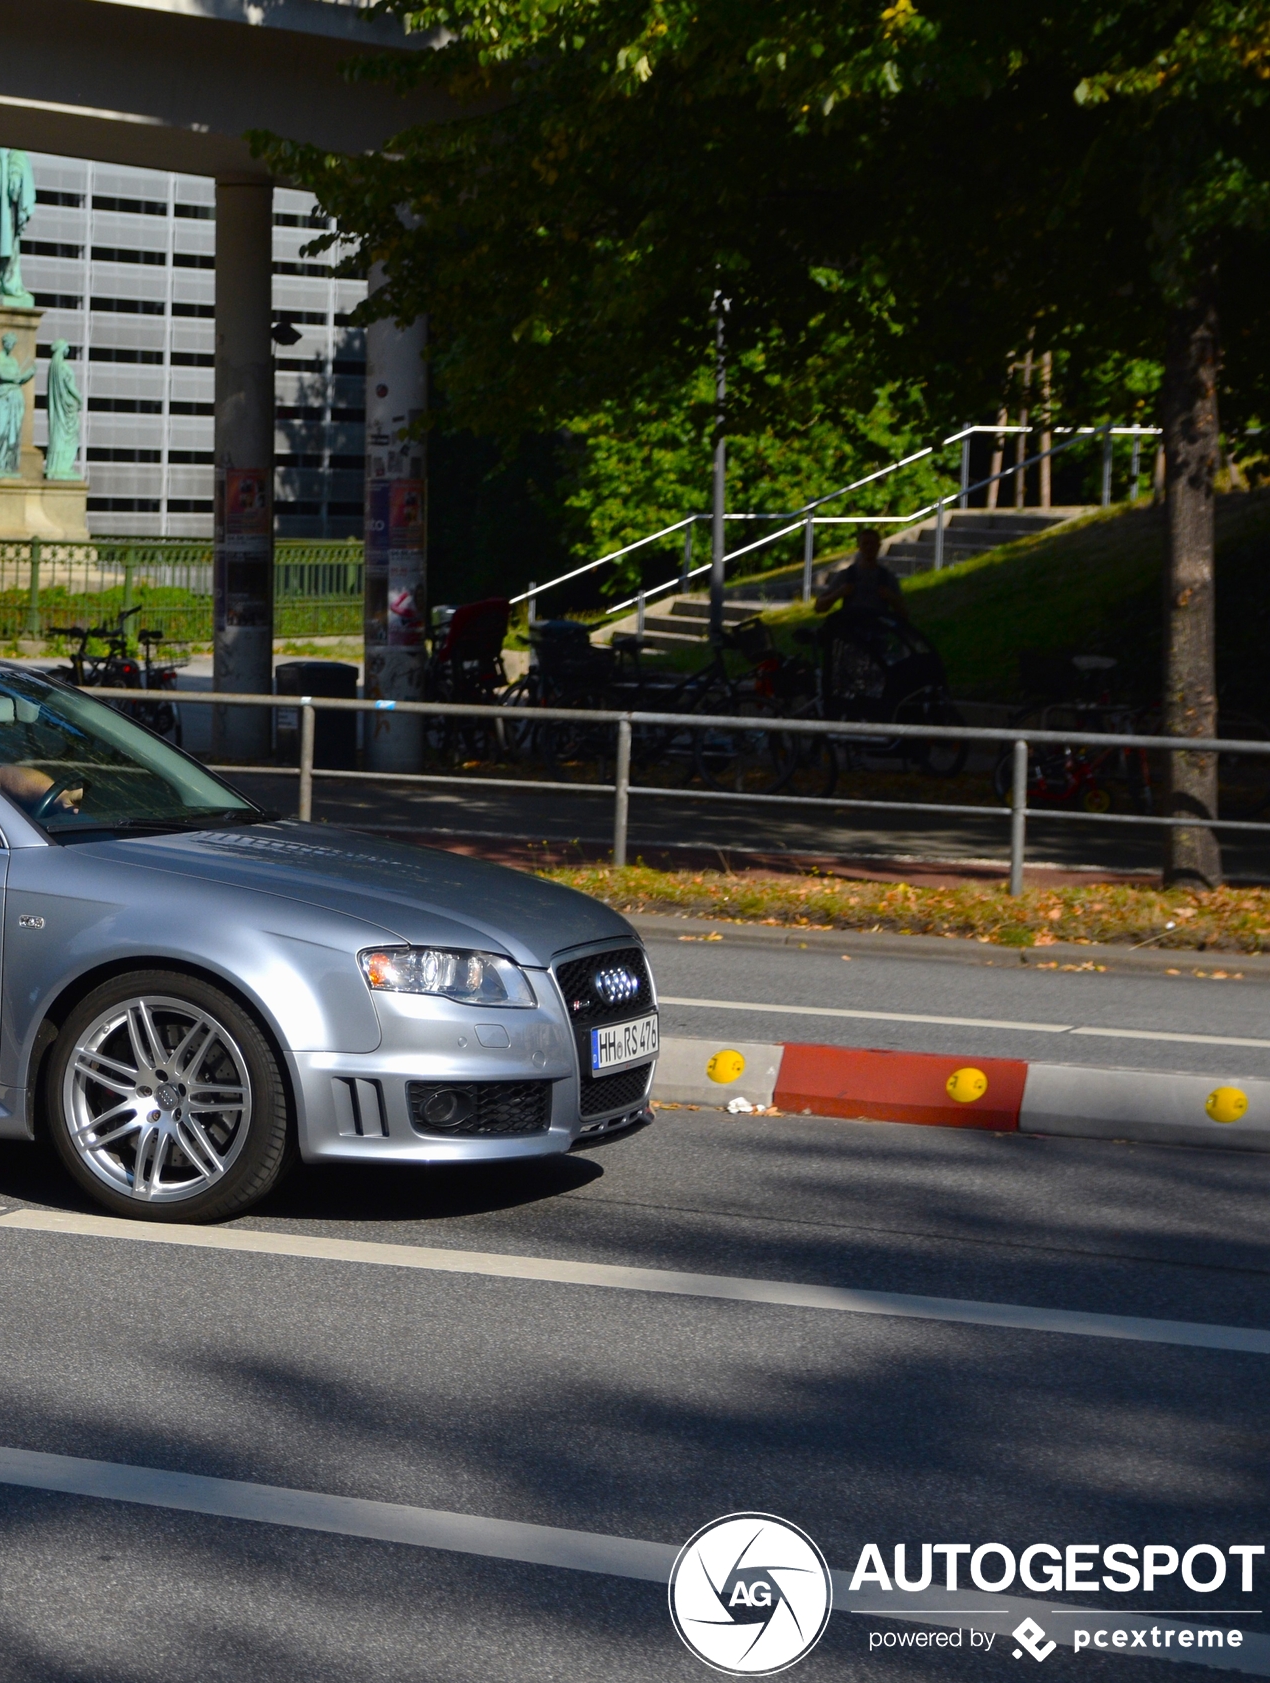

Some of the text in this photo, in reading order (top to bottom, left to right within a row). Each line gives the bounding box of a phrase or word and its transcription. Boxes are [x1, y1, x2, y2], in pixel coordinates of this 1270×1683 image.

[599, 1018, 657, 1063] HH RS 476
